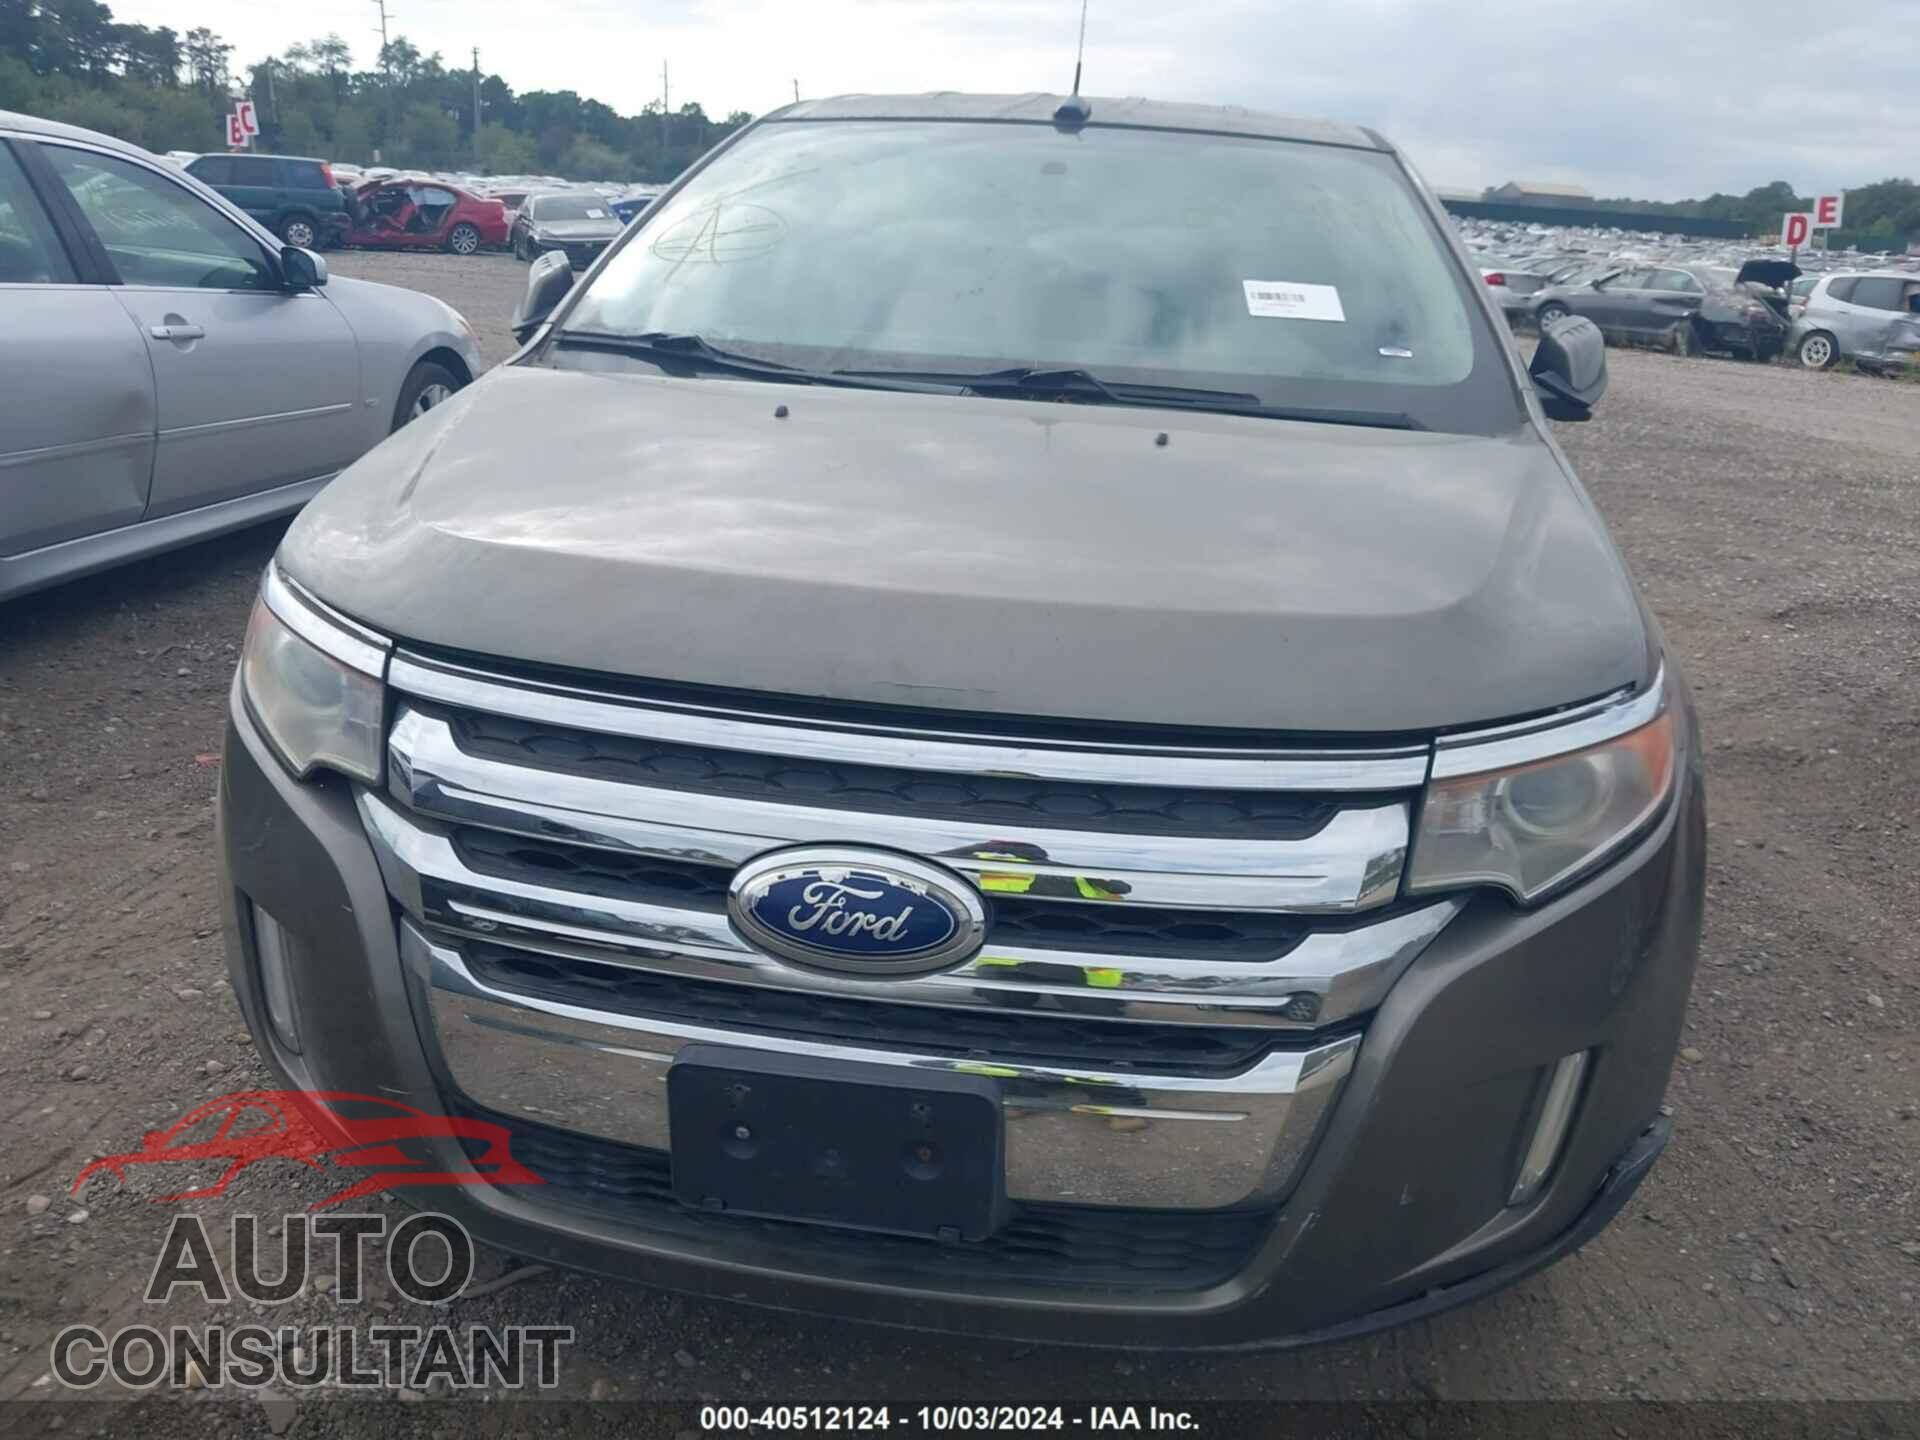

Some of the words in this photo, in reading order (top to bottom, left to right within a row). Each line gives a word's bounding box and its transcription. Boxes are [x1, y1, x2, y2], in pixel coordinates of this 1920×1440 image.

[241, 105, 255, 133] C
[1818, 196, 1839, 224] E
[1787, 215, 1808, 245] D
[788, 881, 914, 942] Ford
